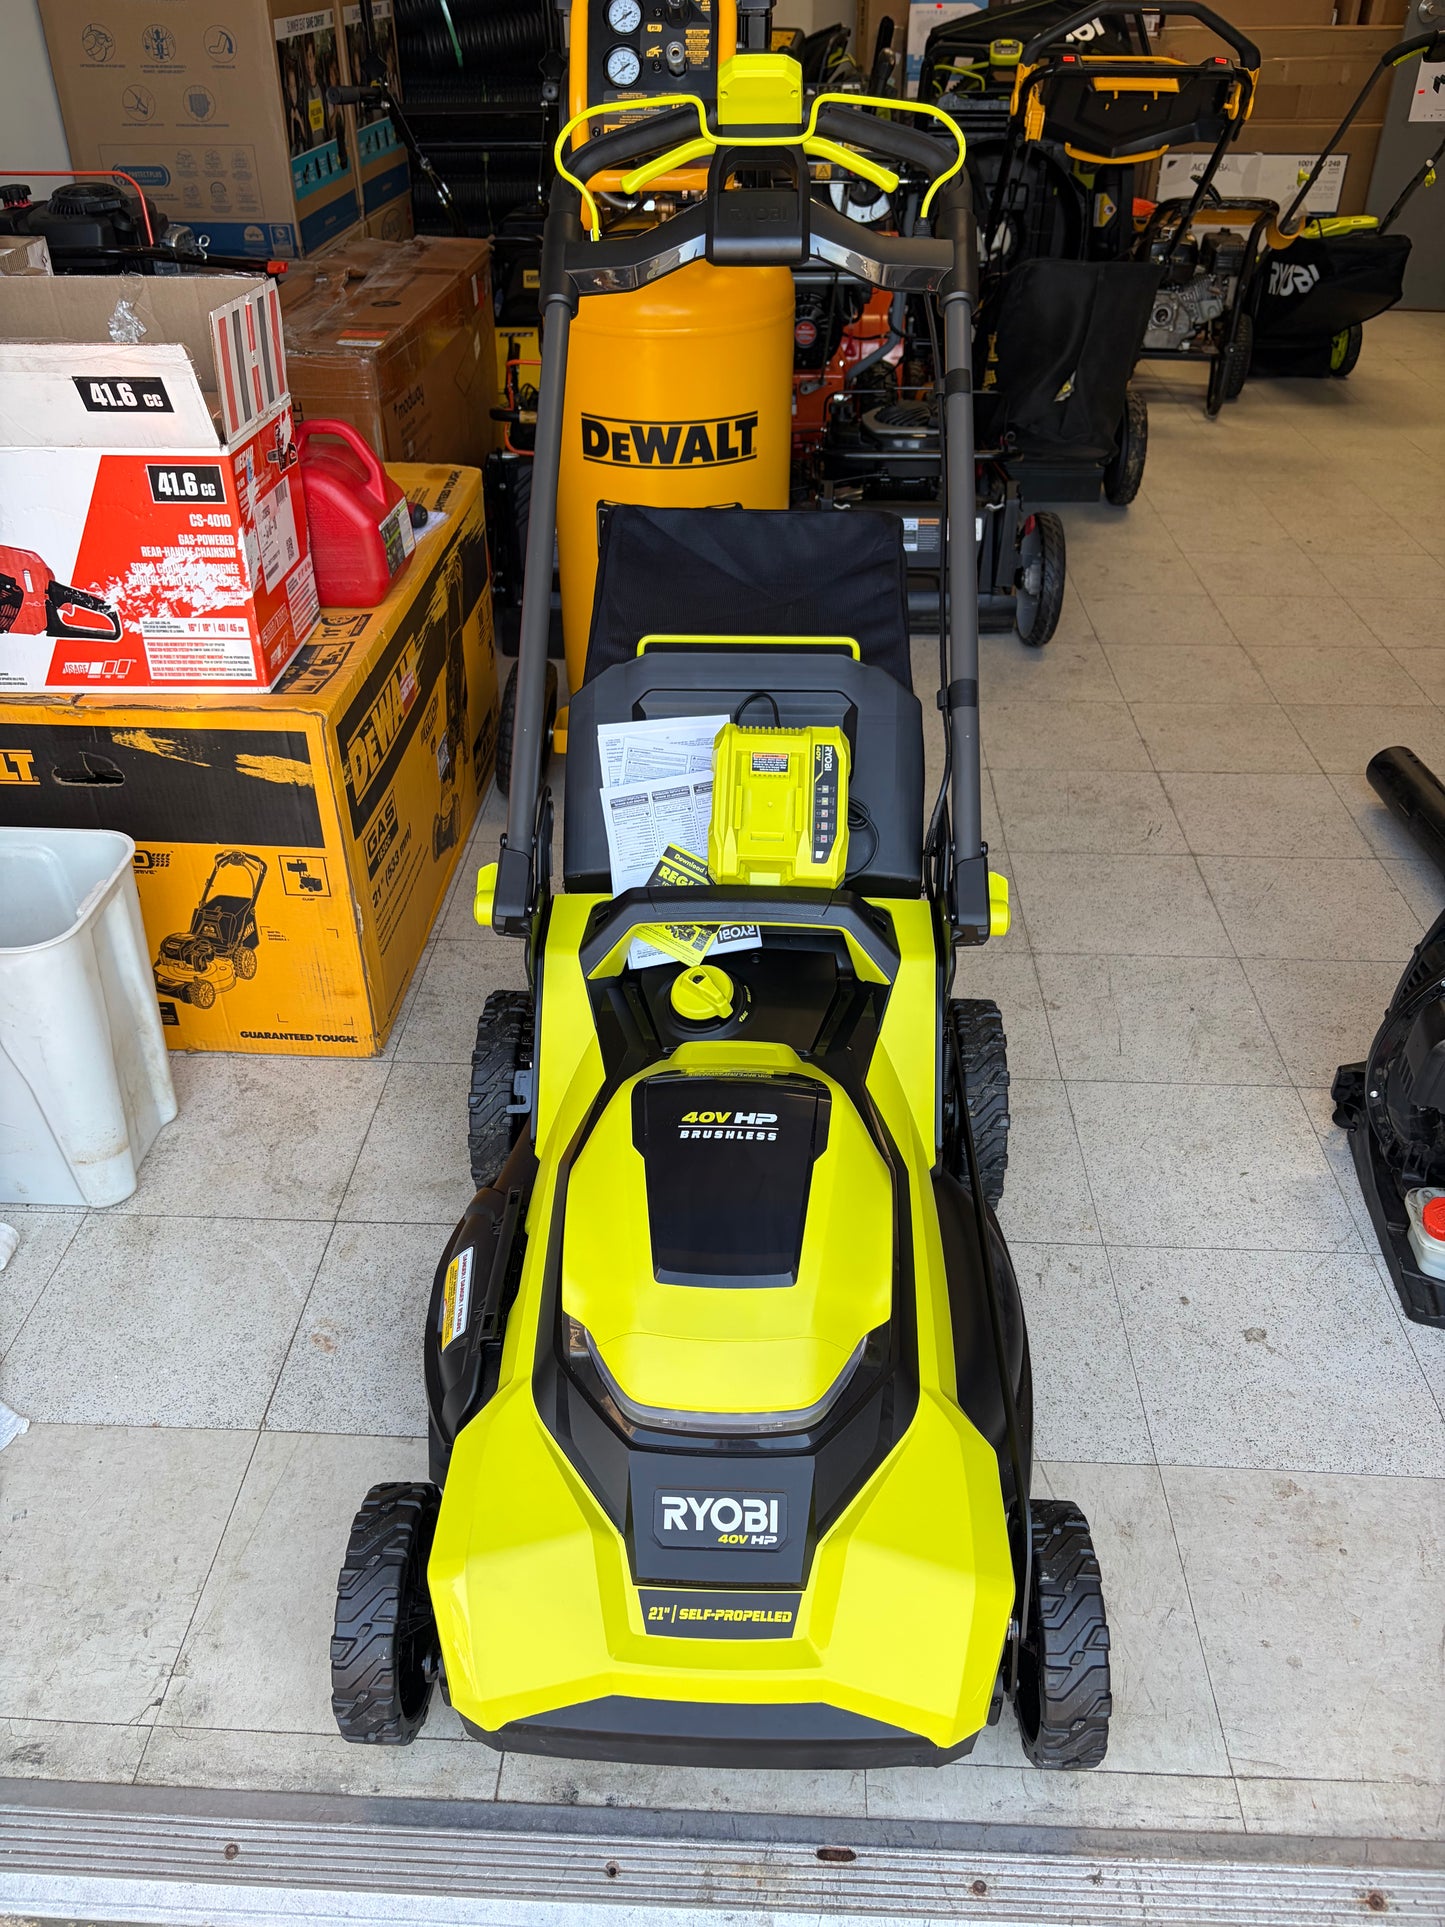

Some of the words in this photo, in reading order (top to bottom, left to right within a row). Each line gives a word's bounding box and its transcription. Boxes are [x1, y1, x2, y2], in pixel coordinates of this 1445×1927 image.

[1268, 261, 1320, 297] RYOBI
[89, 382, 138, 407] 41.6
[158, 472, 199, 496] 41.6
[189, 513, 232, 528] CS-4010
[178, 533, 235, 546] GAS-POWERED
[195, 547, 237, 558] CHAINSAW
[367, 800, 396, 859] GAS
[674, 853, 705, 874] Download
[240, 1031, 314, 1041] GUARANTEED
[681, 1111, 732, 1124] 40V
[733, 1112, 778, 1125] HP
[679, 1130, 778, 1141] BRUSHLESS
[661, 1496, 779, 1534] RYOBI
[717, 1534, 749, 1545] 40V
[750, 1535, 778, 1545] HP
[647, 1606, 671, 1621] 21"
[678, 1608, 793, 1623] SELF-PROPELLED
